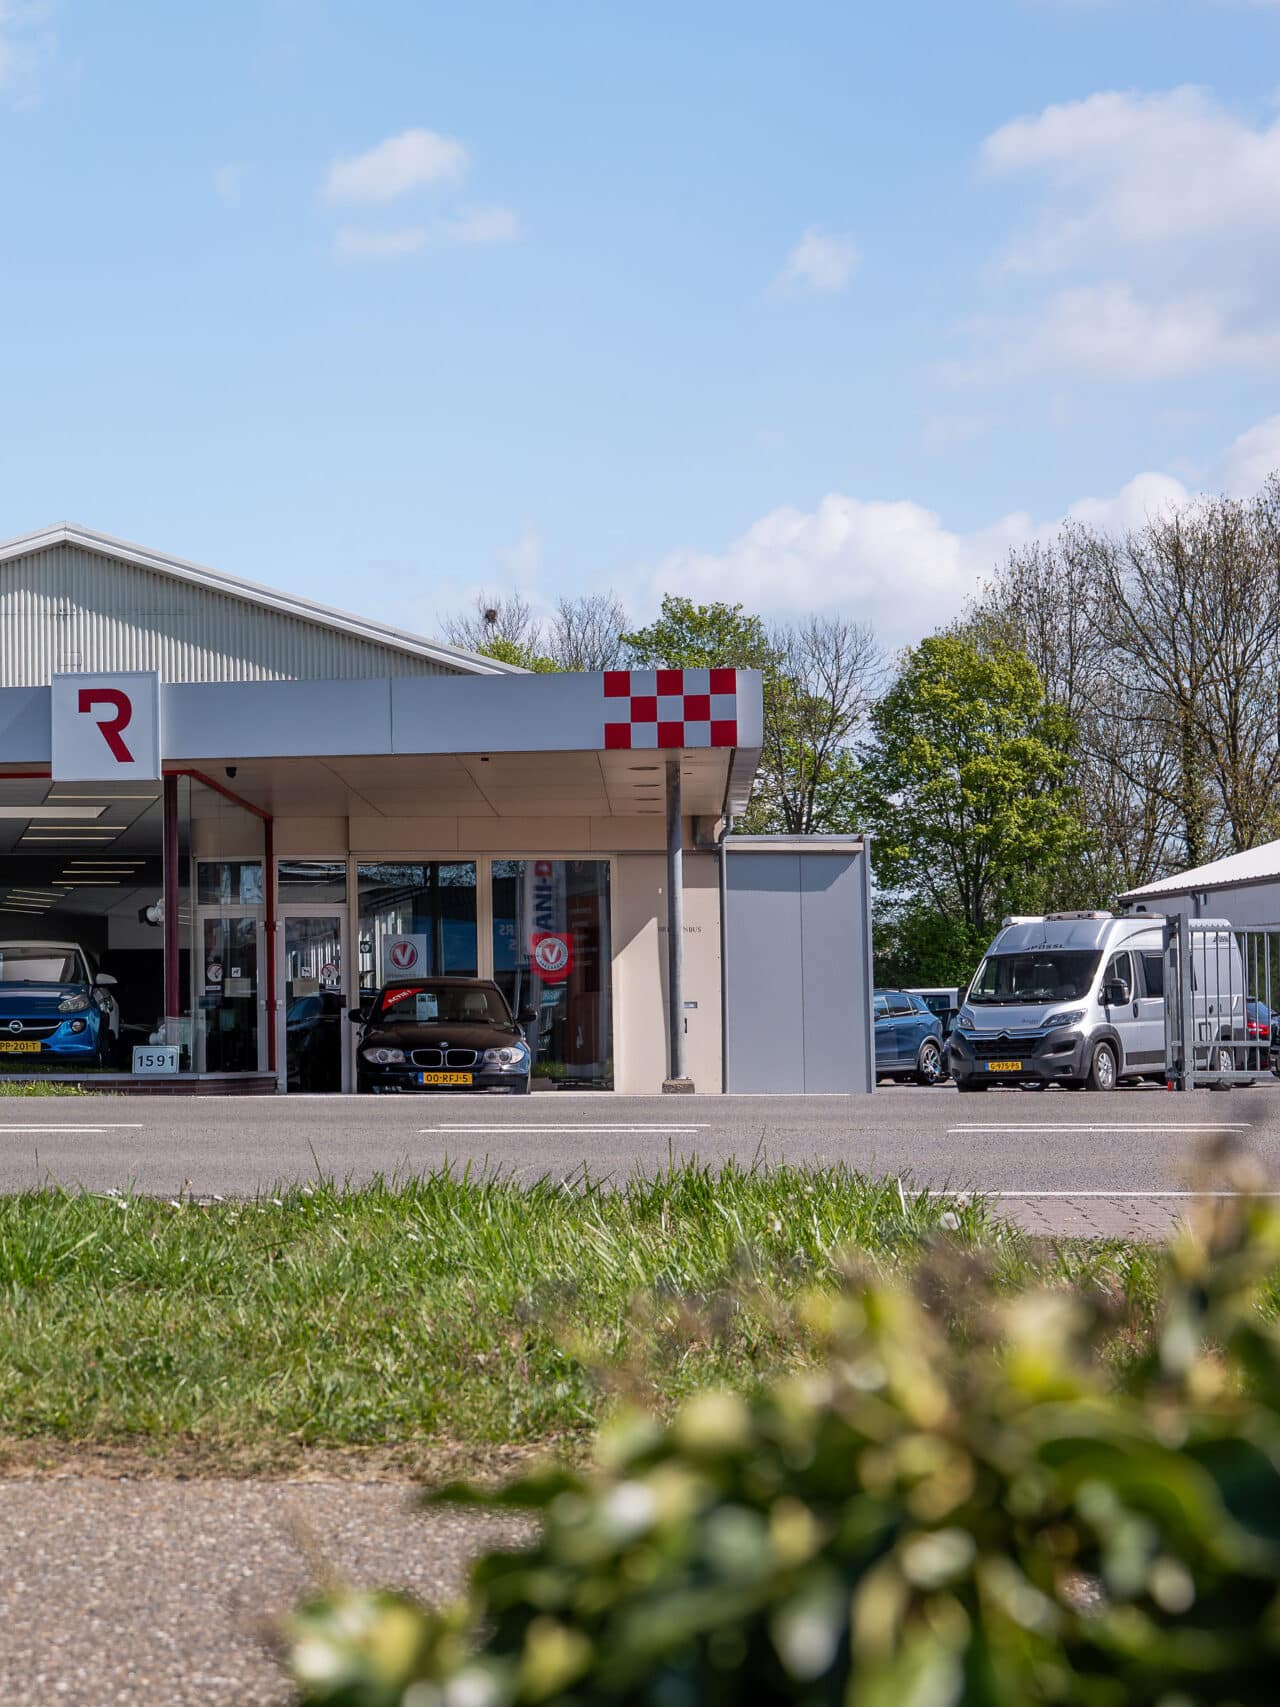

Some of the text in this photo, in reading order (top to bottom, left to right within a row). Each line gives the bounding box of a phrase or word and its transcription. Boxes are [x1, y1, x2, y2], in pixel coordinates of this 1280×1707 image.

[78, 689, 135, 762] R
[0, 1042, 38, 1051] PP-201-T
[137, 1055, 175, 1067] 1591
[426, 1074, 469, 1083] 00-RFJ-5
